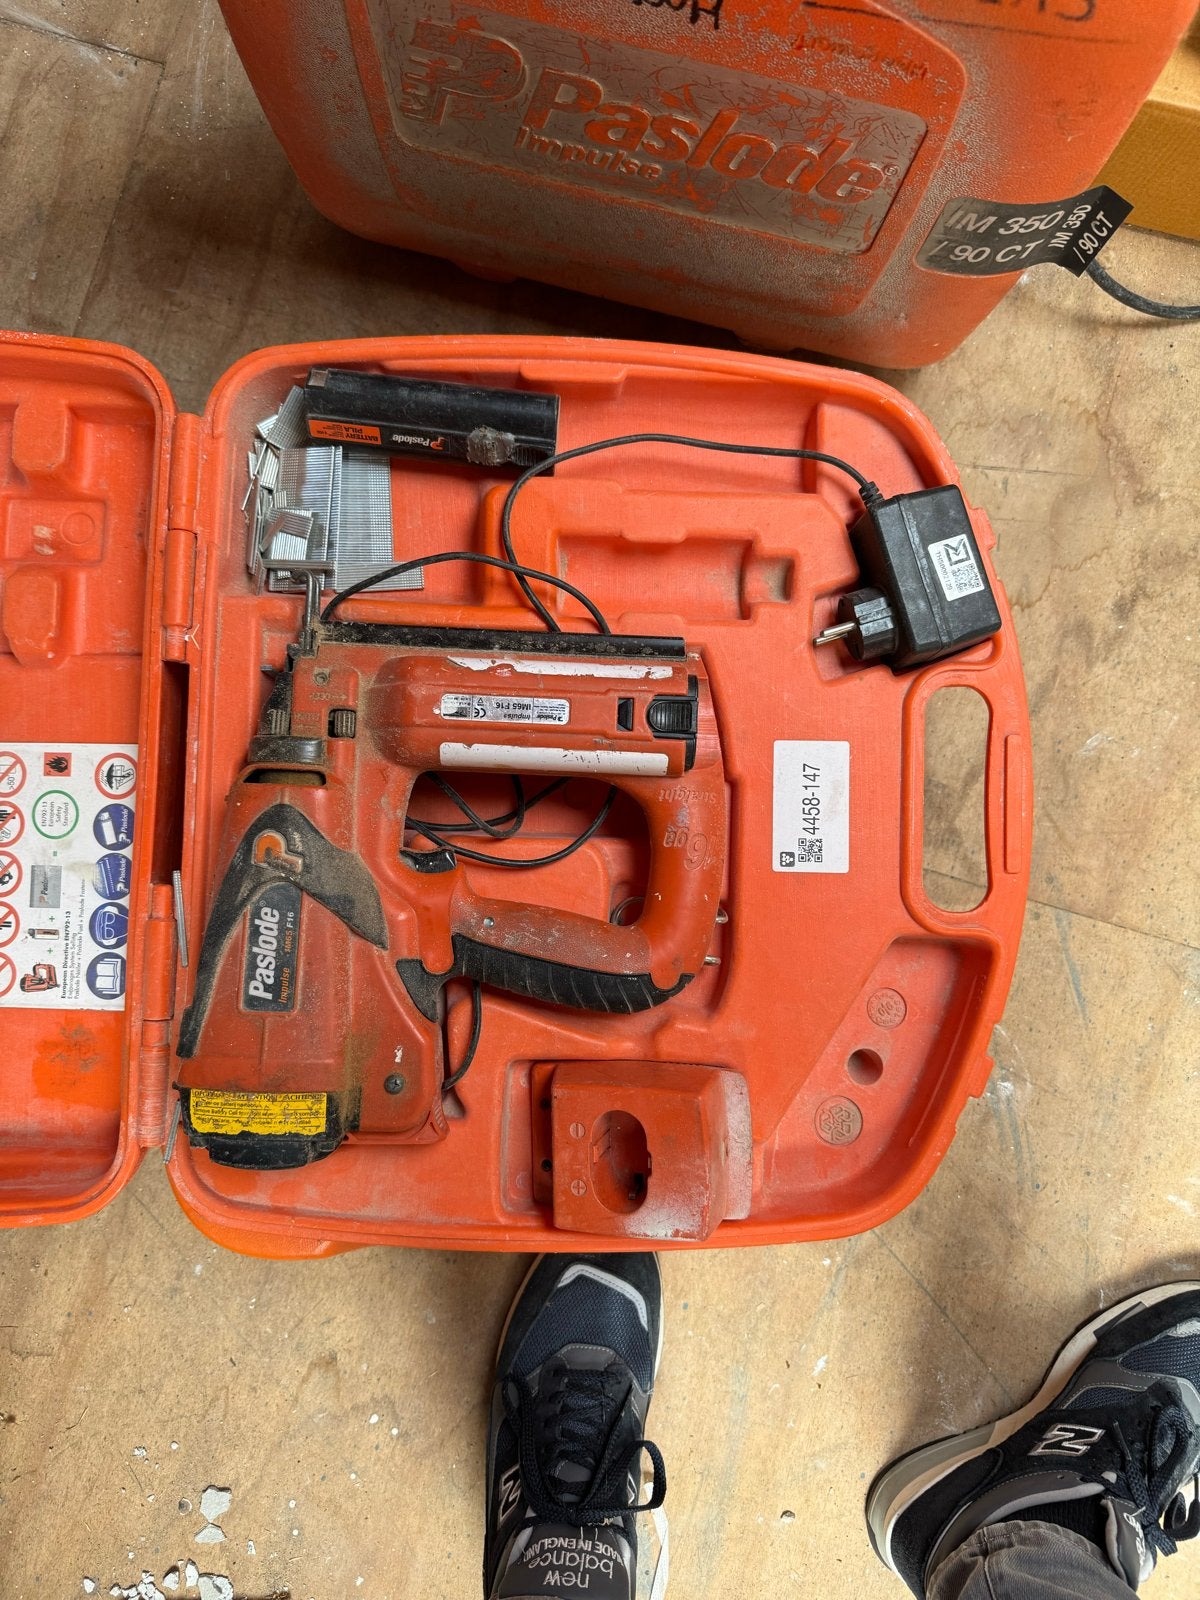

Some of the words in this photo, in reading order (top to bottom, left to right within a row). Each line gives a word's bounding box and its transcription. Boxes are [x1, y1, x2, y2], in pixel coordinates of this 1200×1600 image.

[522, 66, 885, 204] Paslode
[513, 125, 663, 180] Impulse
[944, 210, 998, 235] IM
[998, 210, 1066, 235] 350
[1048, 231, 1074, 248] IM
[1062, 204, 1093, 229] 350
[1078, 232, 1100, 255] 90
[1091, 211, 1114, 238] CT
[950, 245, 992, 264] 90
[996, 239, 1046, 263] CT
[343, 426, 364, 435] PILA
[345, 431, 379, 443] BATTERY
[393, 434, 430, 448] Paslode
[495, 702, 510, 710] F16
[802, 763, 820, 835] 4458-147
[55, 806, 63, 823] Safety
[286, 911, 295, 928] F16
[248, 906, 280, 1000] Paslode
[284, 929, 294, 953] IM65
[279, 967, 290, 1003] Impulse
[523, 1537, 577, 1562] ENGLAND
[579, 1539, 592, 1550] IN
[528, 1549, 614, 1579] balance
[543, 1570, 589, 1588] new
